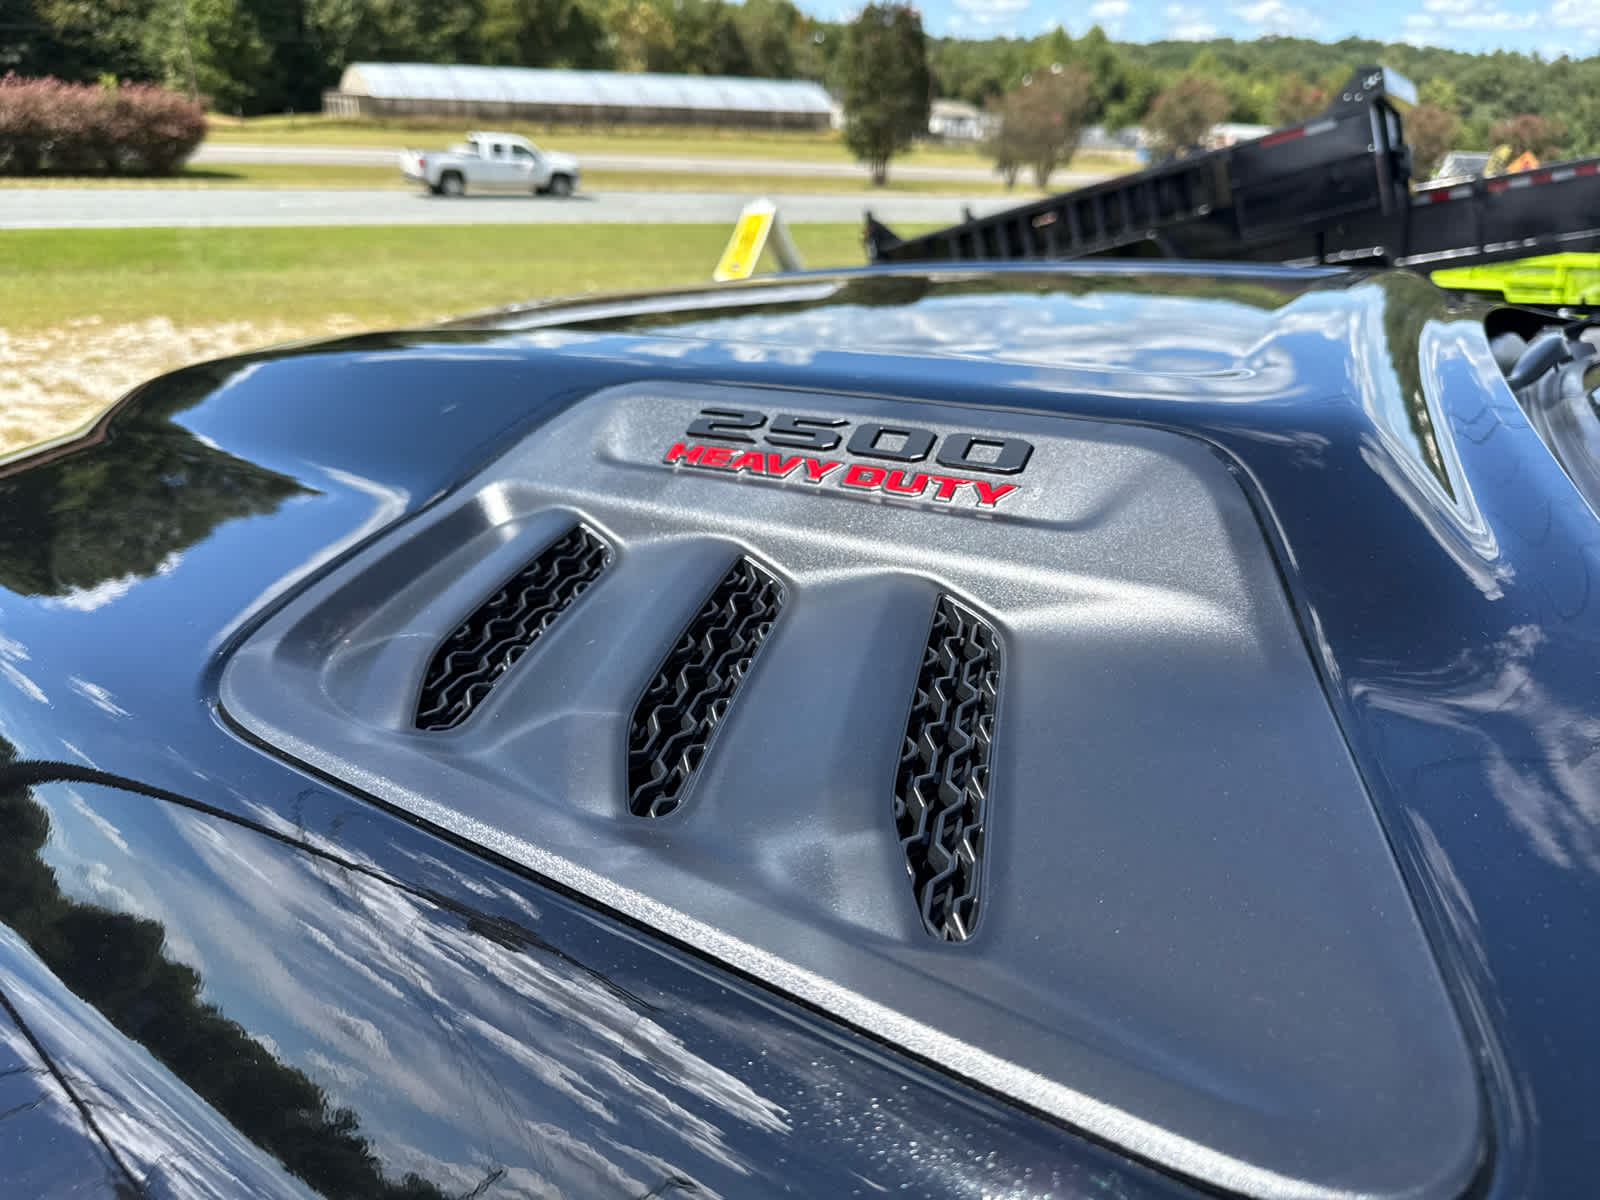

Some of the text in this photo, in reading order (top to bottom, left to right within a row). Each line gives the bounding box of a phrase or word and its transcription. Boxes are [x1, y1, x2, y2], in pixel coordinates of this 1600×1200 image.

[663, 441, 1020, 508] HEAVY DUTY
[686, 406, 1035, 475] 2500
